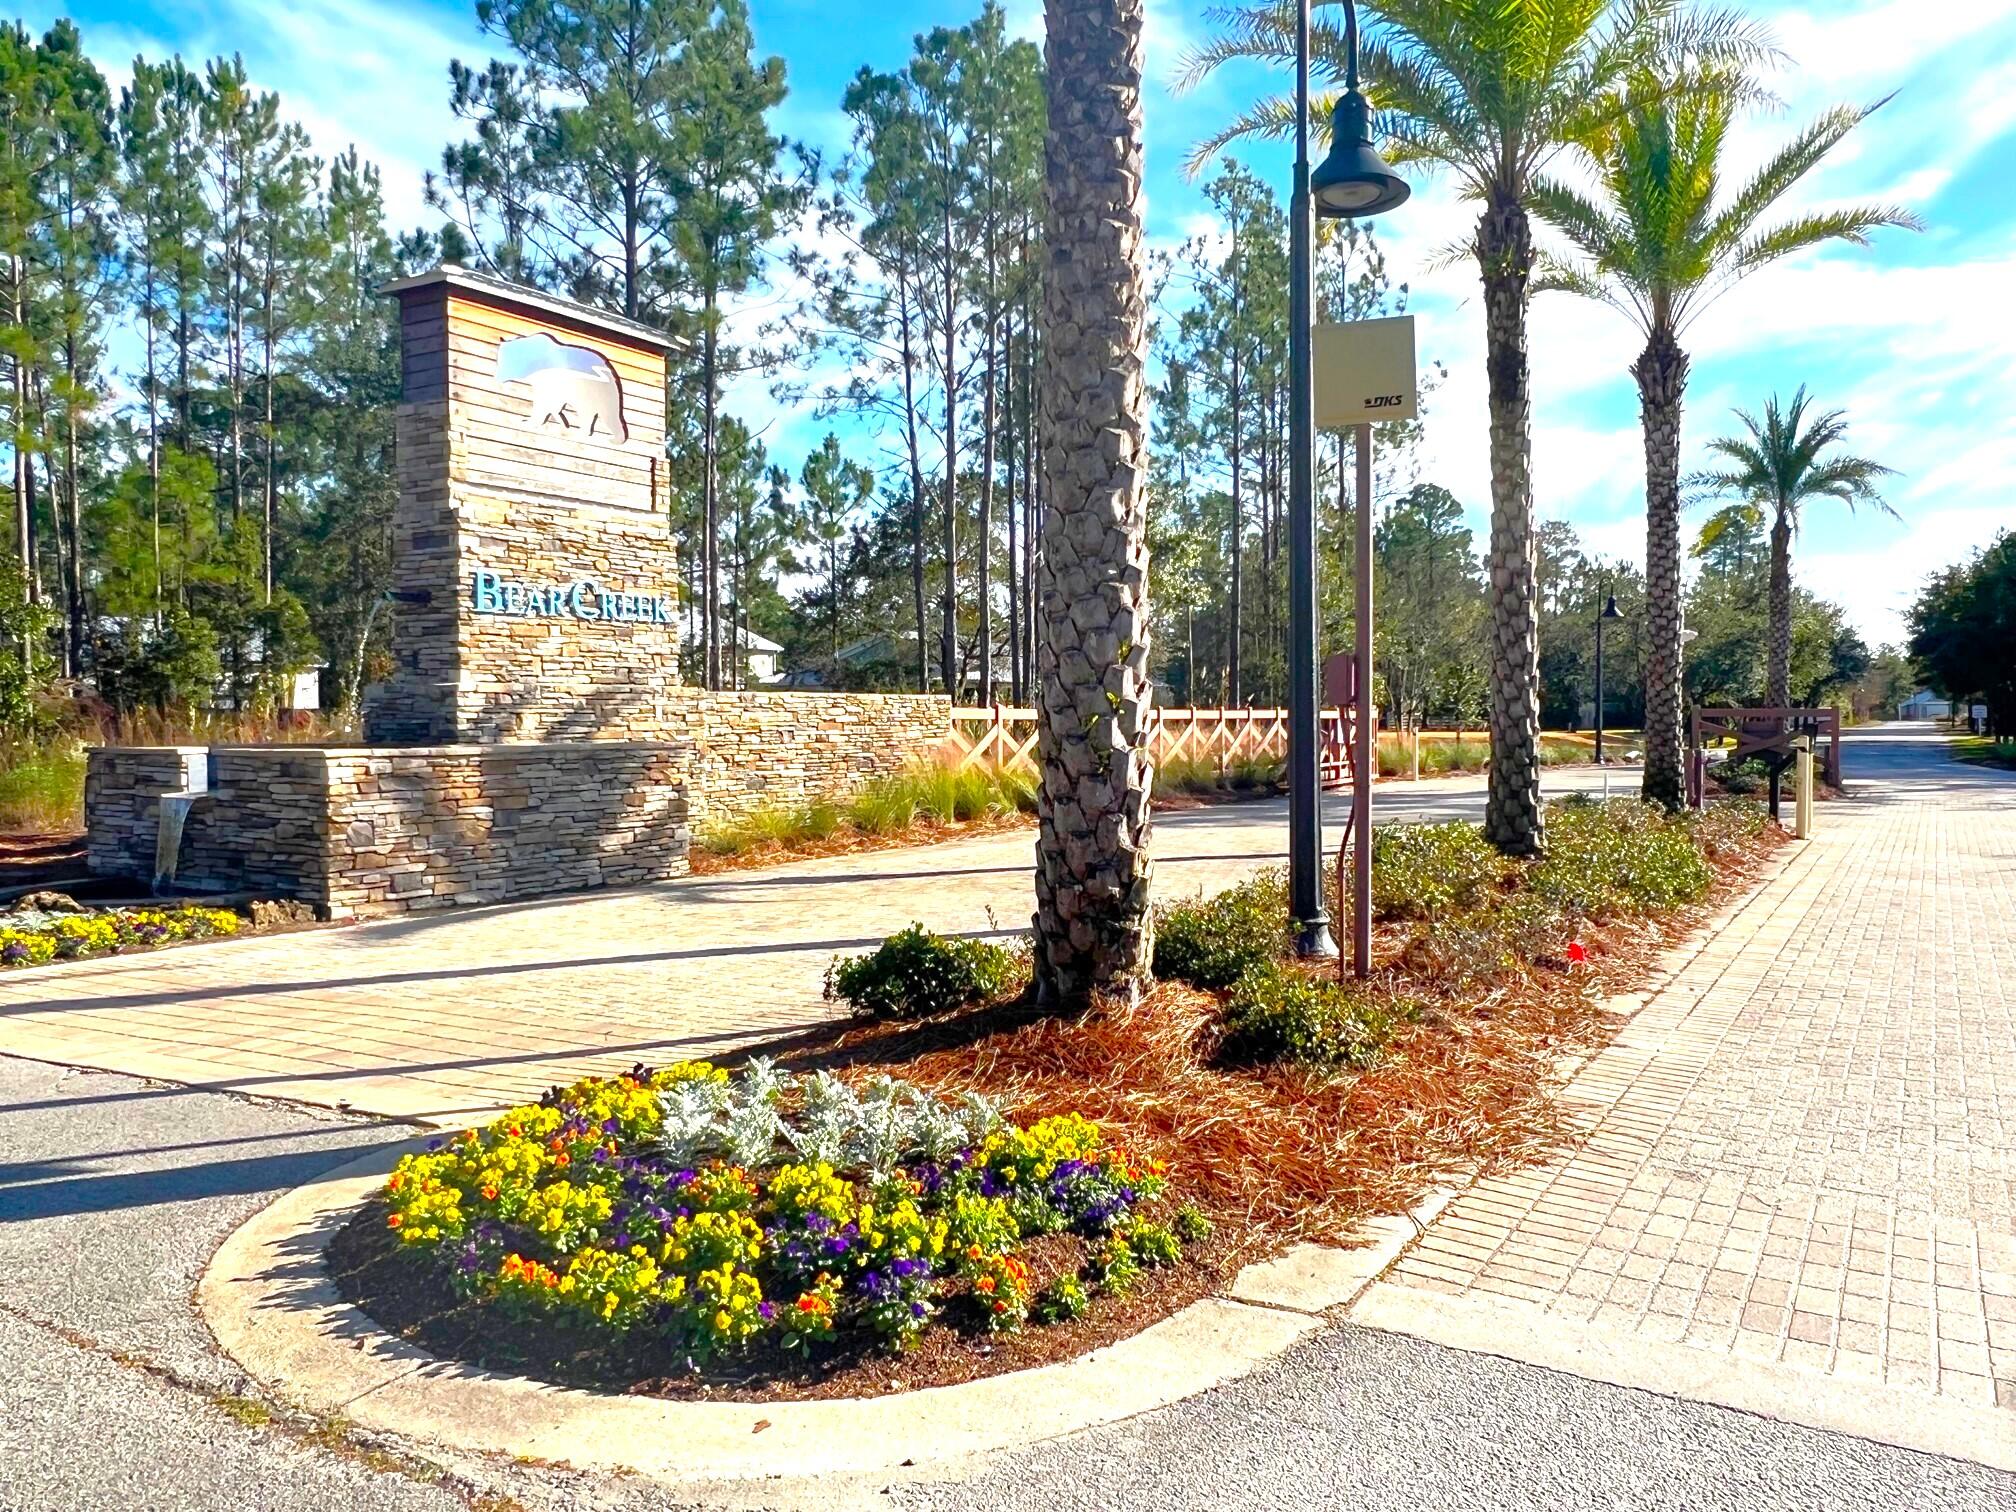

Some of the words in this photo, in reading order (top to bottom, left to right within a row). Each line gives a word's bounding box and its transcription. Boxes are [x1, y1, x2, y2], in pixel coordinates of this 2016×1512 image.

[1364, 395, 1403, 408] DKS
[474, 567, 567, 617] BEAR
[571, 579, 675, 623] CREEK
